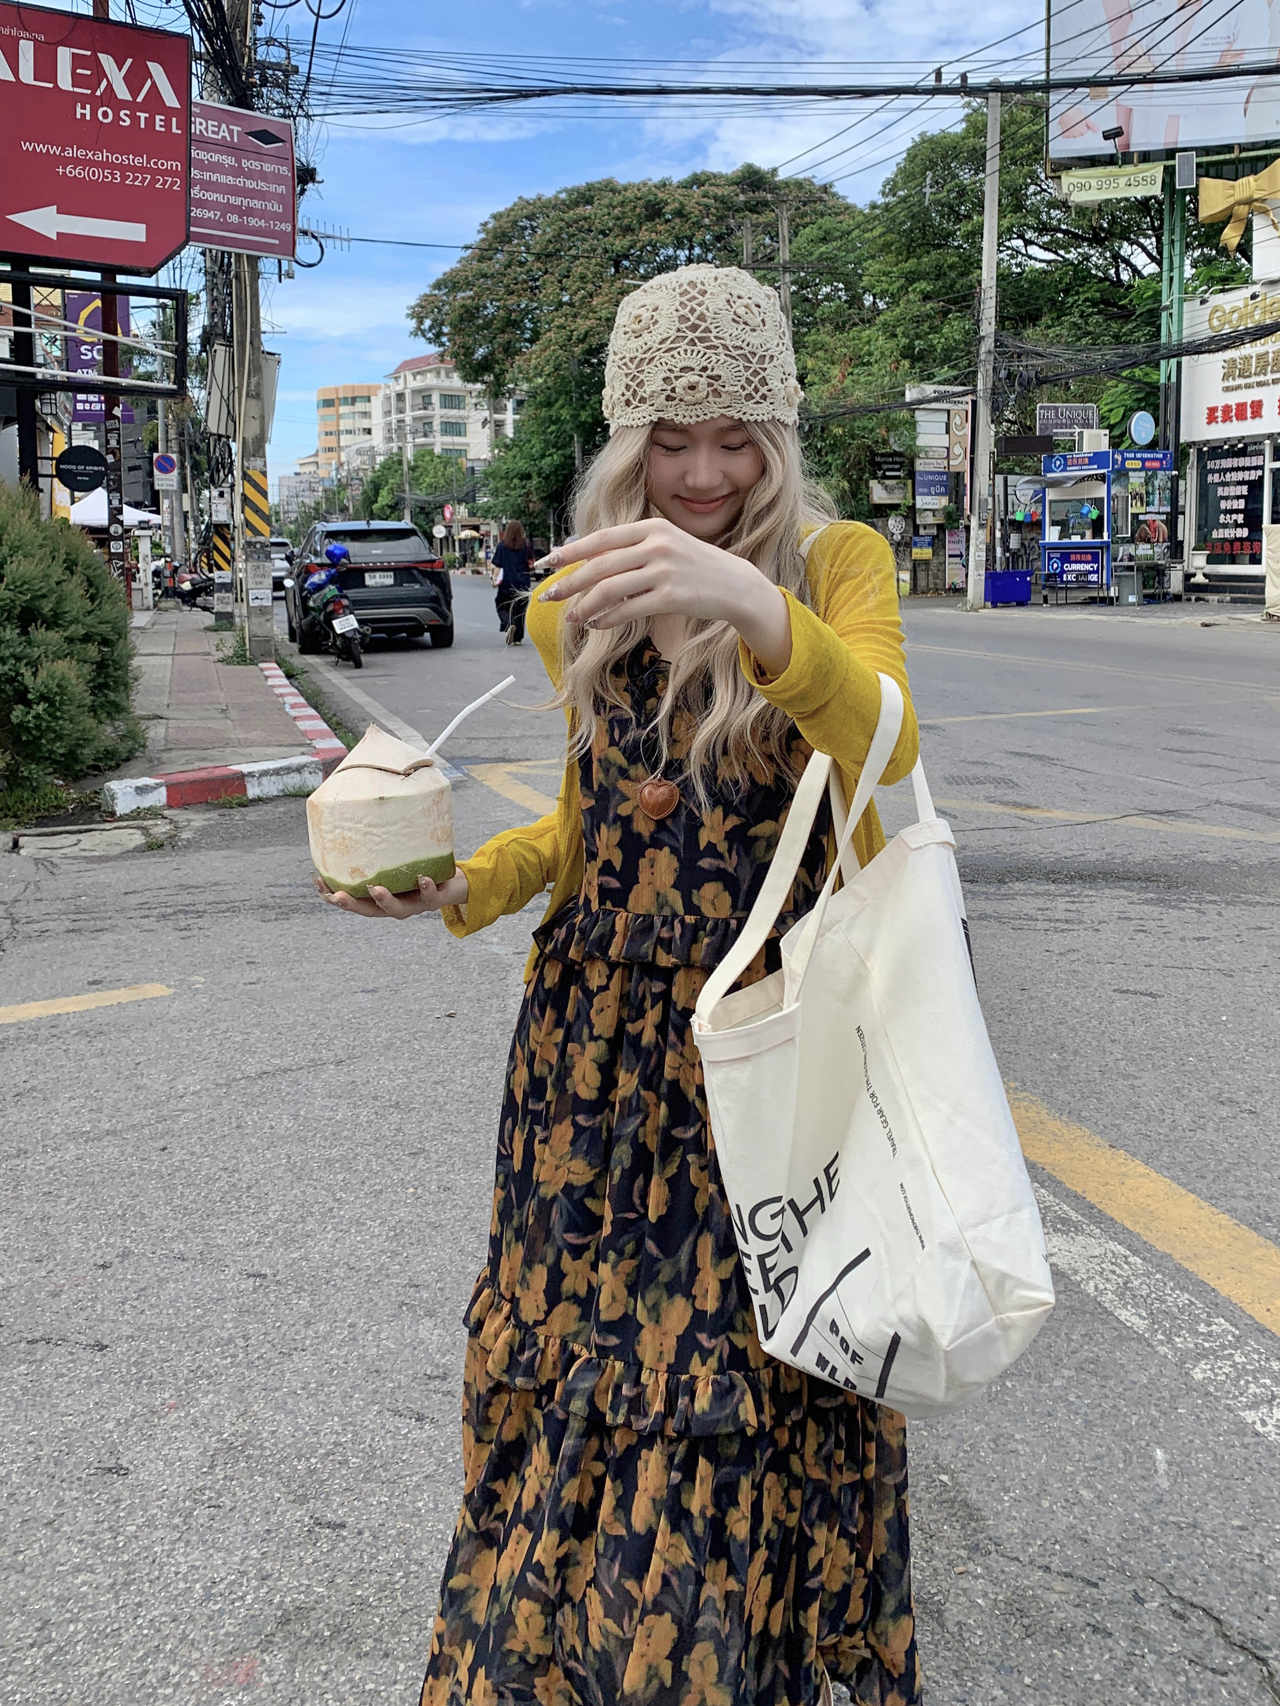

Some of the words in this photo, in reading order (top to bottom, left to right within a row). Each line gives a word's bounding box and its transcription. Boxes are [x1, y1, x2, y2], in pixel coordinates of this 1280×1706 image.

[75, 102, 182, 134] HOSTEL
[20, 140, 182, 172] www.alexahostel.com
[55, 165, 122, 184] +66(0)53
[125, 172, 151, 187] 227
[154, 176, 181, 190] 272
[1067, 181, 1092, 194] 090
[1095, 177, 1120, 190] 995
[1124, 174, 1157, 188] 4558
[226, 213, 291, 233] 08-1904-1249
[80, 345, 104, 360] SC
[1039, 409, 1056, 419] THE
[1058, 408, 1094, 420] UNIQUE
[1206, 399, 1264, 426] 买卖租赁
[1063, 563, 1098, 571] CURRENCY
[869, 1090, 880, 1109] FOR
[876, 1104, 889, 1129] GEAR
[886, 1127, 898, 1158] TRAVEL
[828, 1317, 865, 1367] POF
